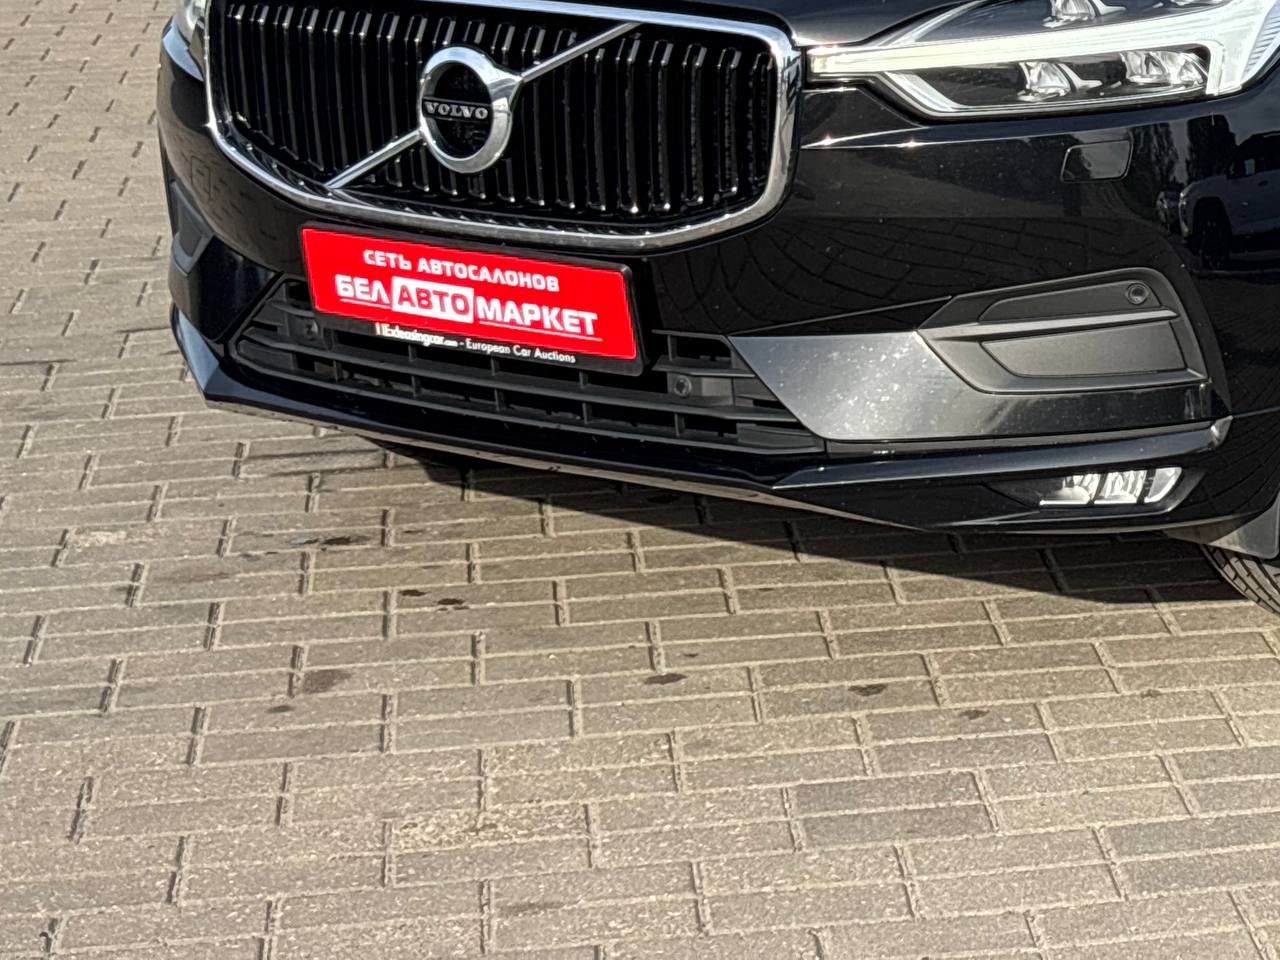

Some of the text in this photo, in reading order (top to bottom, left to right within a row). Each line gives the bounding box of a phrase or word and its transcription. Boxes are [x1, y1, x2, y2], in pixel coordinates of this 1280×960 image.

[424, 101, 489, 120] VOLVO
[363, 248, 560, 292] СЕТЬ АВТОСАЛОНОВ
[466, 337, 511, 355] European
[513, 344, 532, 357] Car
[534, 347, 576, 364] Auctions
